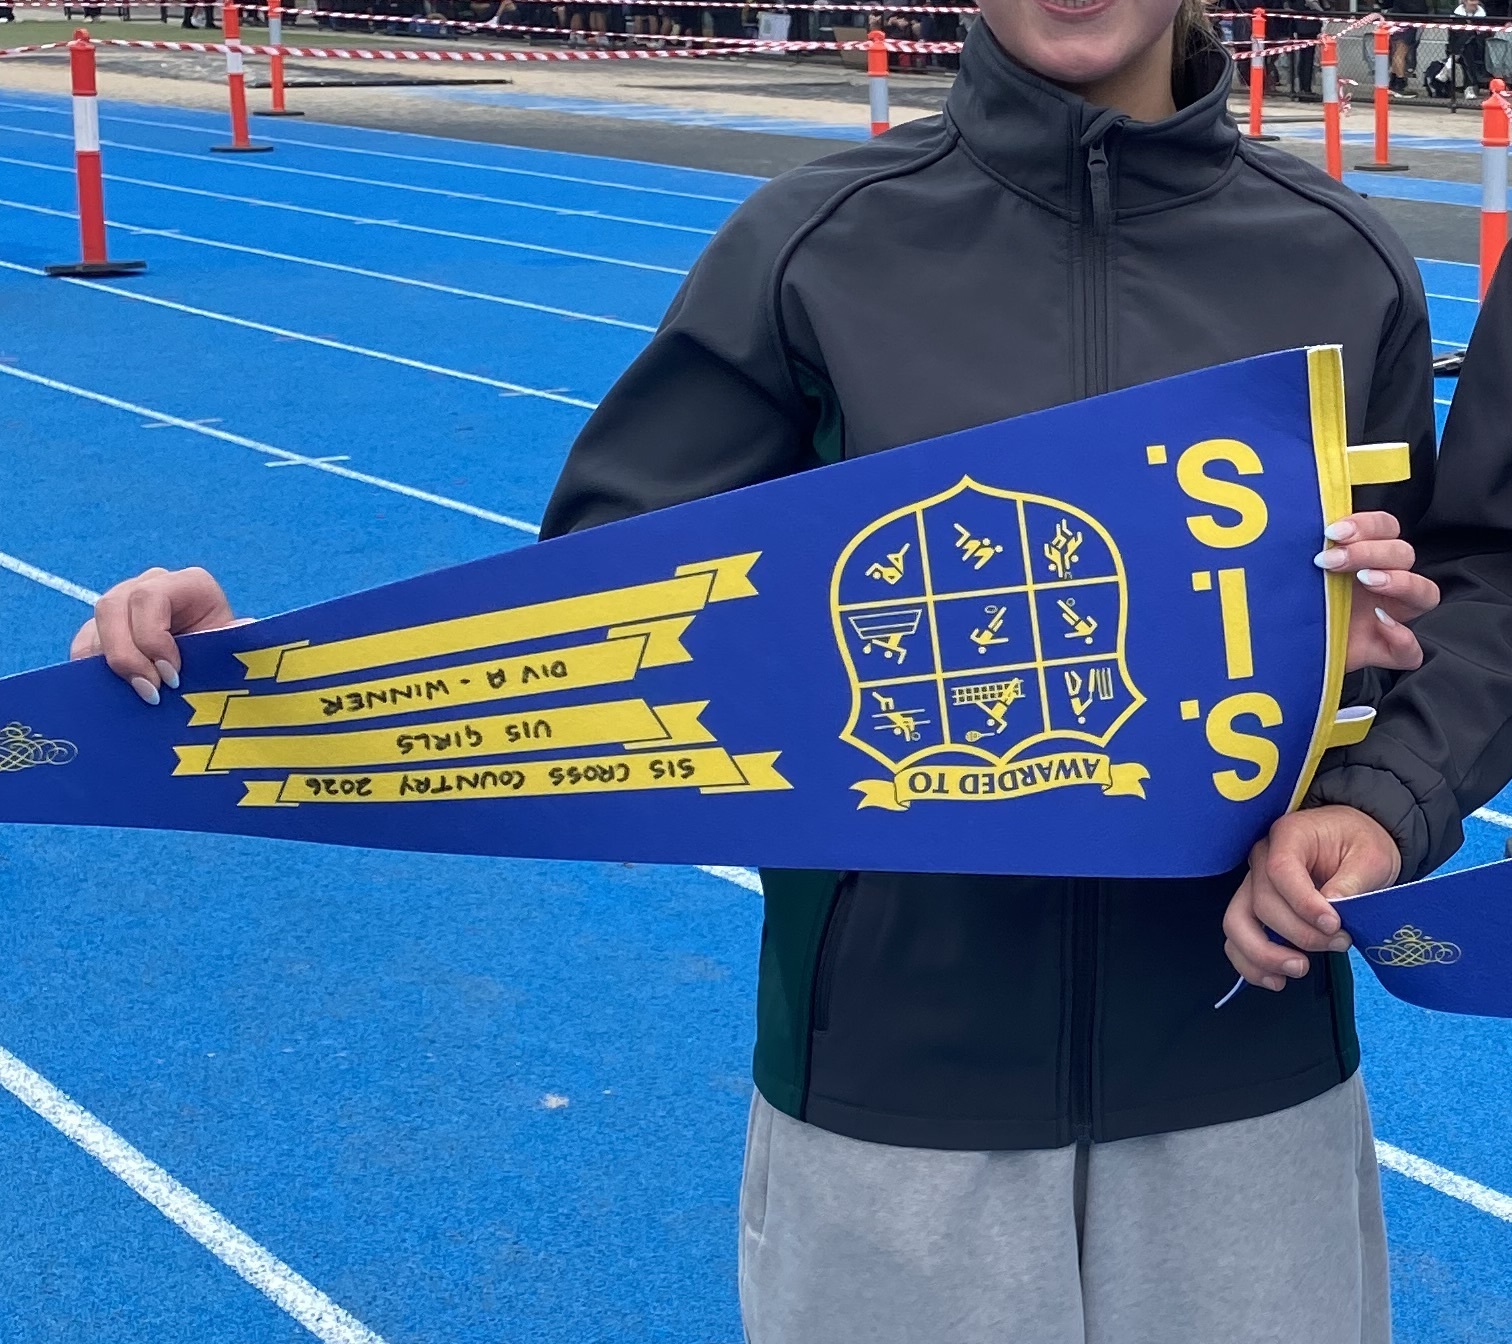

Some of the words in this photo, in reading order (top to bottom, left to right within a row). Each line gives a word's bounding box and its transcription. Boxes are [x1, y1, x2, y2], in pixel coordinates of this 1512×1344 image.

[486, 668, 507, 690] A
[521, 660, 569, 684] DIV
[319, 678, 451, 717] WINNER
[396, 724, 483, 755] GIRLS
[548, 762, 630, 786] CROSS
[648, 757, 696, 780] SIS
[959, 757, 1101, 795] AWARDED
[304, 776, 373, 796] 2026
[399, 769, 526, 796] COUNTRY
[908, 772, 950, 795] TO
